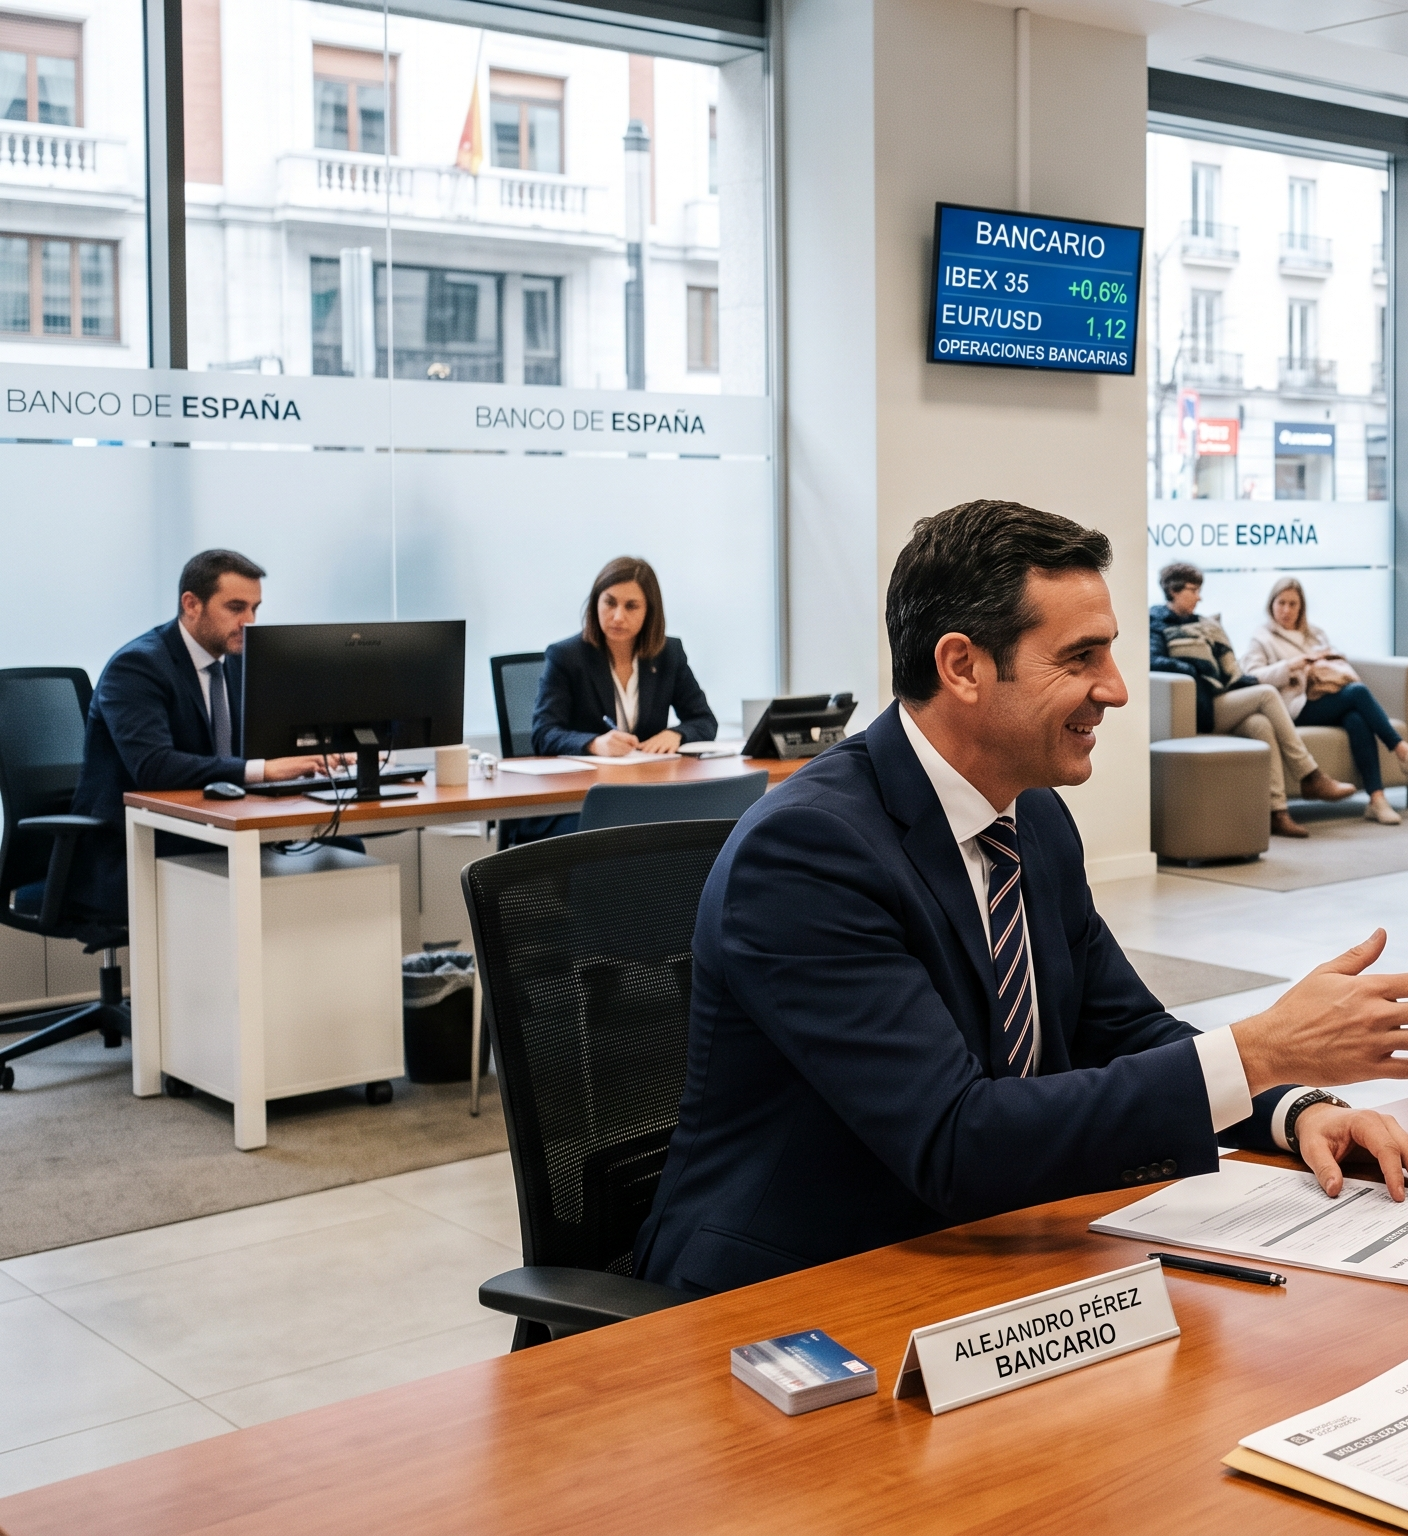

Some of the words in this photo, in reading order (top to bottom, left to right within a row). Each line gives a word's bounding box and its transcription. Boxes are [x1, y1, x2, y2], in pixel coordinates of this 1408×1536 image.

[975, 220, 1106, 259] BANCARIO
[944, 265, 998, 291] IBEX
[1004, 271, 1030, 294] 35
[1068, 279, 1128, 305] +0,6%
[941, 303, 1043, 332] EUR/USD
[1086, 316, 1127, 340] 1,12
[937, 338, 1045, 360] OPERACIONES
[1048, 346, 1129, 367] BANCARIAS
[6, 389, 122, 417] BANCO
[131, 393, 173, 418] DE
[182, 392, 302, 421] ESPAÑA
[475, 405, 565, 431] BANCO
[573, 409, 605, 432] DE
[611, 408, 706, 435] ESPAÑA
[1201, 523, 1229, 547] DE
[1235, 518, 1319, 546] ESPAÑA
[954, 1308, 1075, 1362] ALEJANDRO
[1078, 1286, 1142, 1323] PÉREZ
[995, 1322, 1117, 1379] BANCARIO
